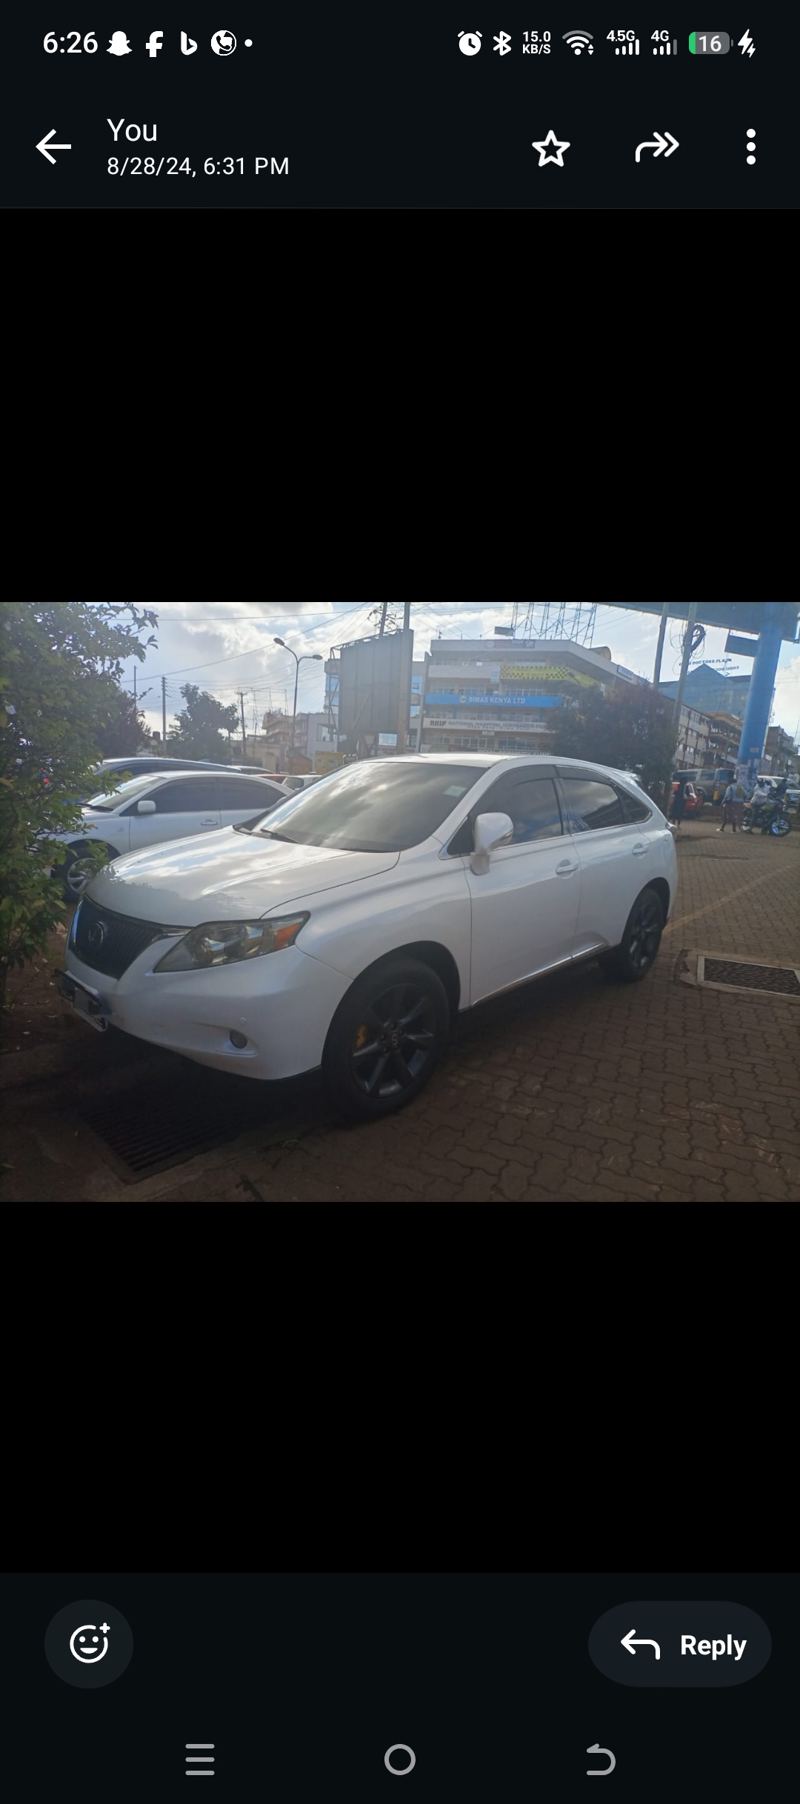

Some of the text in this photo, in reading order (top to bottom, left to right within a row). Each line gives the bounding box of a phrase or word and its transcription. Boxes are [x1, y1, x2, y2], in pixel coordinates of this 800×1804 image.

[43, 31, 98, 54] 6:26
[523, 31, 552, 42] 15.0
[606, 30, 636, 42] 4.5G
[650, 30, 670, 42] 4G
[699, 35, 721, 52] 16
[522, 43, 552, 55] KB/S
[106, 118, 158, 142] You
[107, 156, 289, 178] 8/28/24, 6:31 PM
[680, 1633, 748, 1661] Reply
